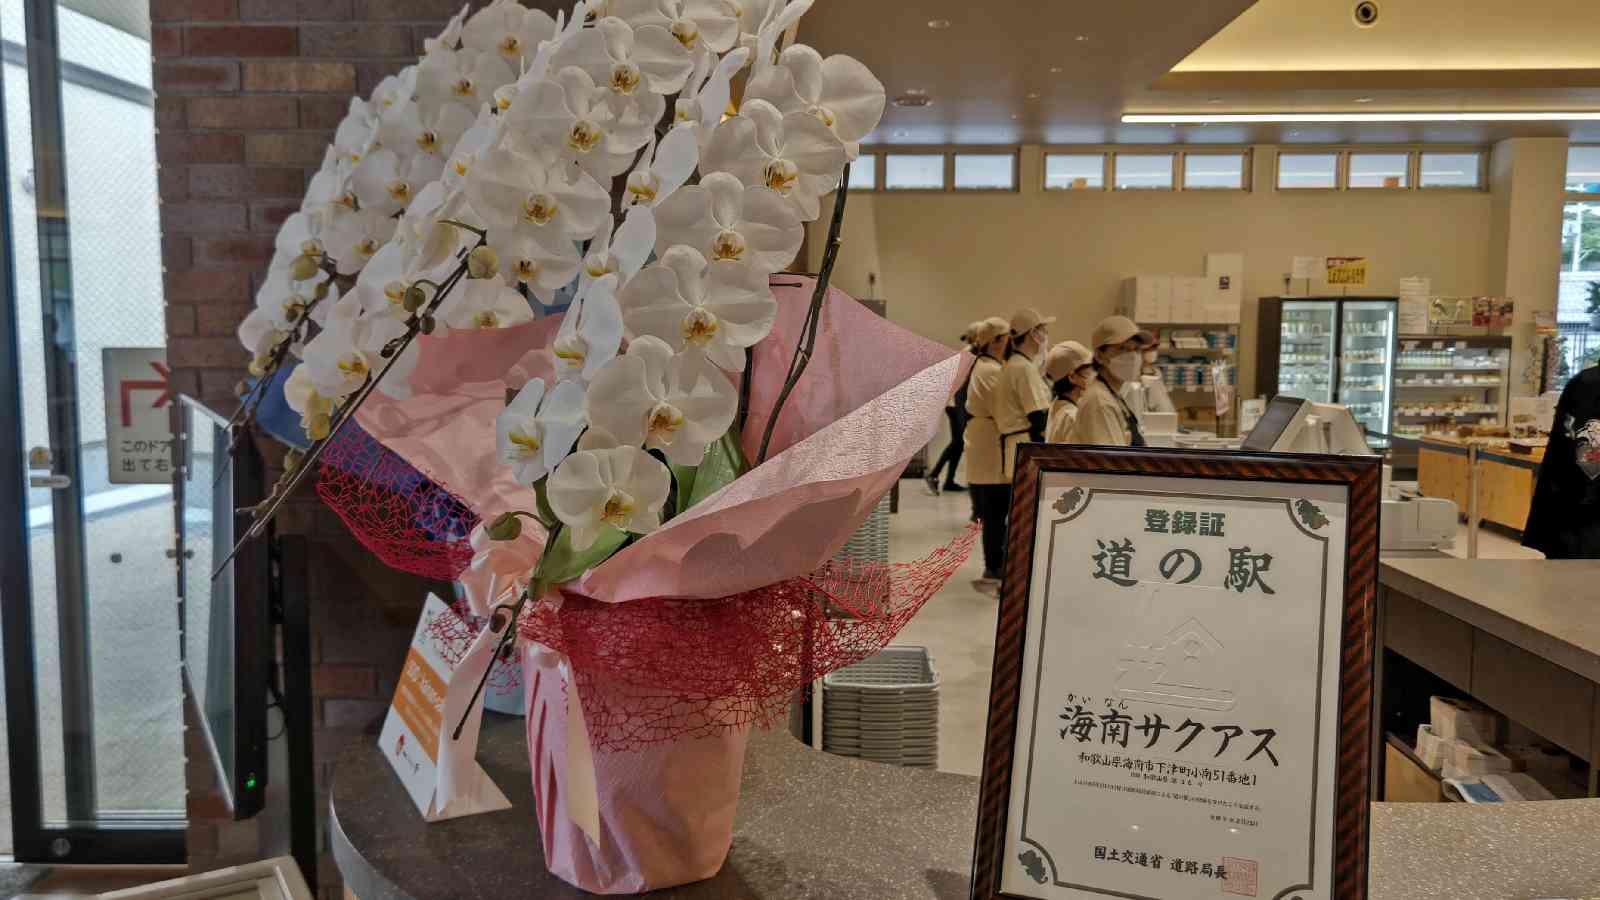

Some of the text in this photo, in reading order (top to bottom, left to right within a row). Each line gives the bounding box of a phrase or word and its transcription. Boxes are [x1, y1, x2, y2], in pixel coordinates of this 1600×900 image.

[1144, 508, 1225, 537] 登録証
[1091, 538, 1275, 595] 道の駅
[1067, 693, 1128, 710] かい なん
[1058, 705, 1279, 767] 海南サクアス
[1094, 846, 1163, 869] 国土交通省
[1170, 858, 1228, 880] 道路局長
